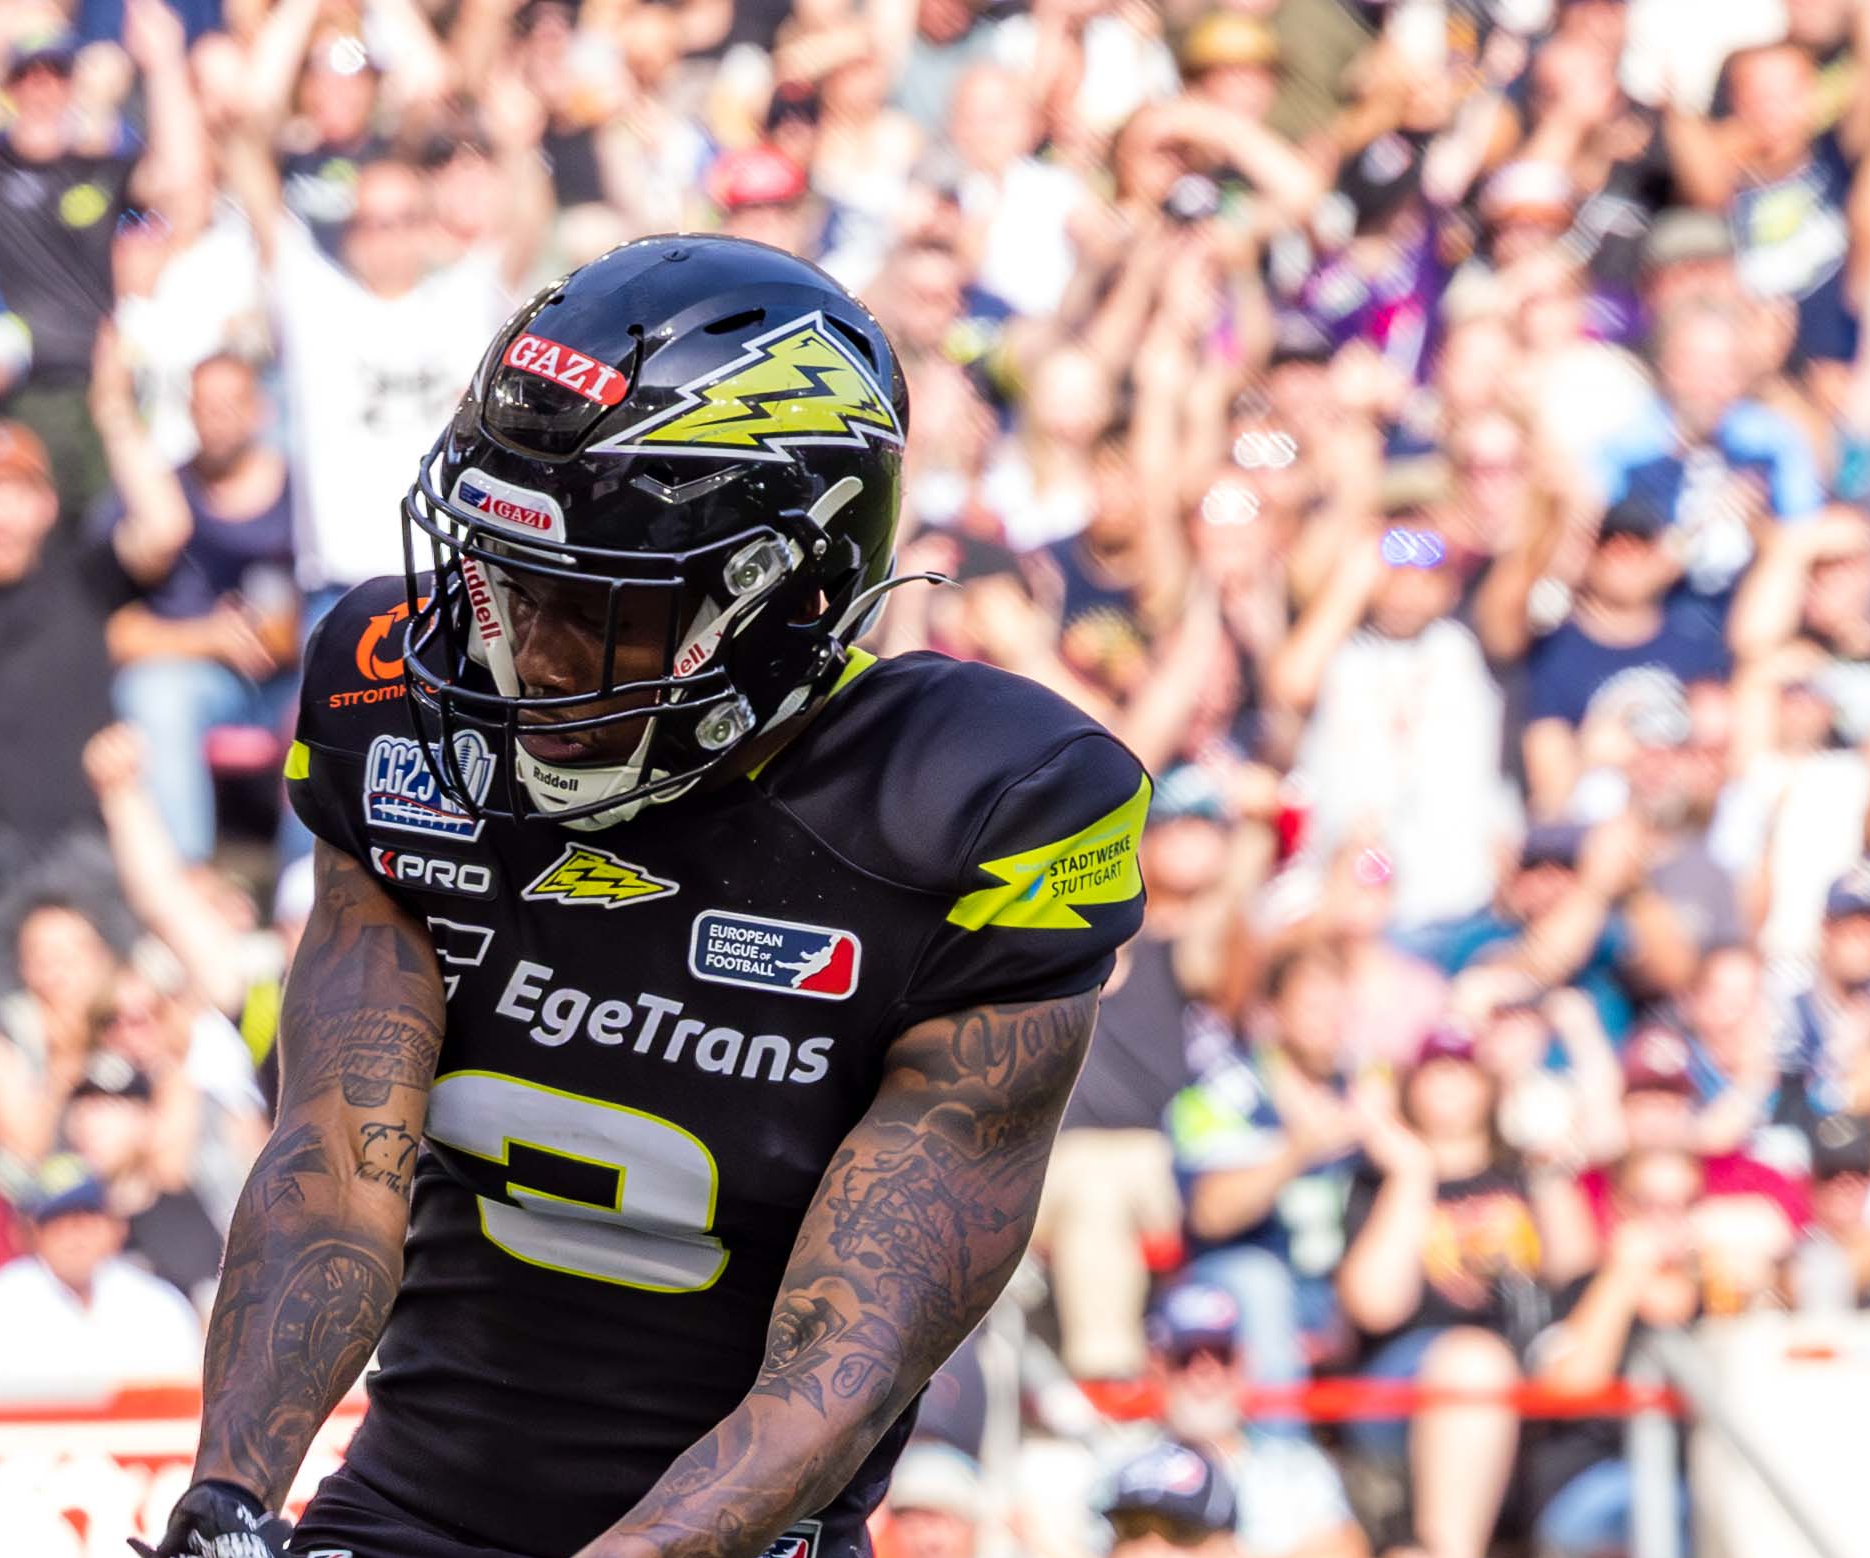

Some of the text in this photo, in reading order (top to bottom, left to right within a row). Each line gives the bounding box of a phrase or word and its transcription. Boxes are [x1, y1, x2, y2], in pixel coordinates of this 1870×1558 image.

[533, 766, 579, 792] Riddell
[1050, 834, 1131, 877] STADTWERKE
[1051, 861, 1122, 898] STUTTGART
[707, 939, 759, 958] LEAGUE
[709, 924, 783, 947] EUROPEAN
[705, 954, 775, 977] FOOTBALL
[495, 961, 834, 1083] EgeTrans
